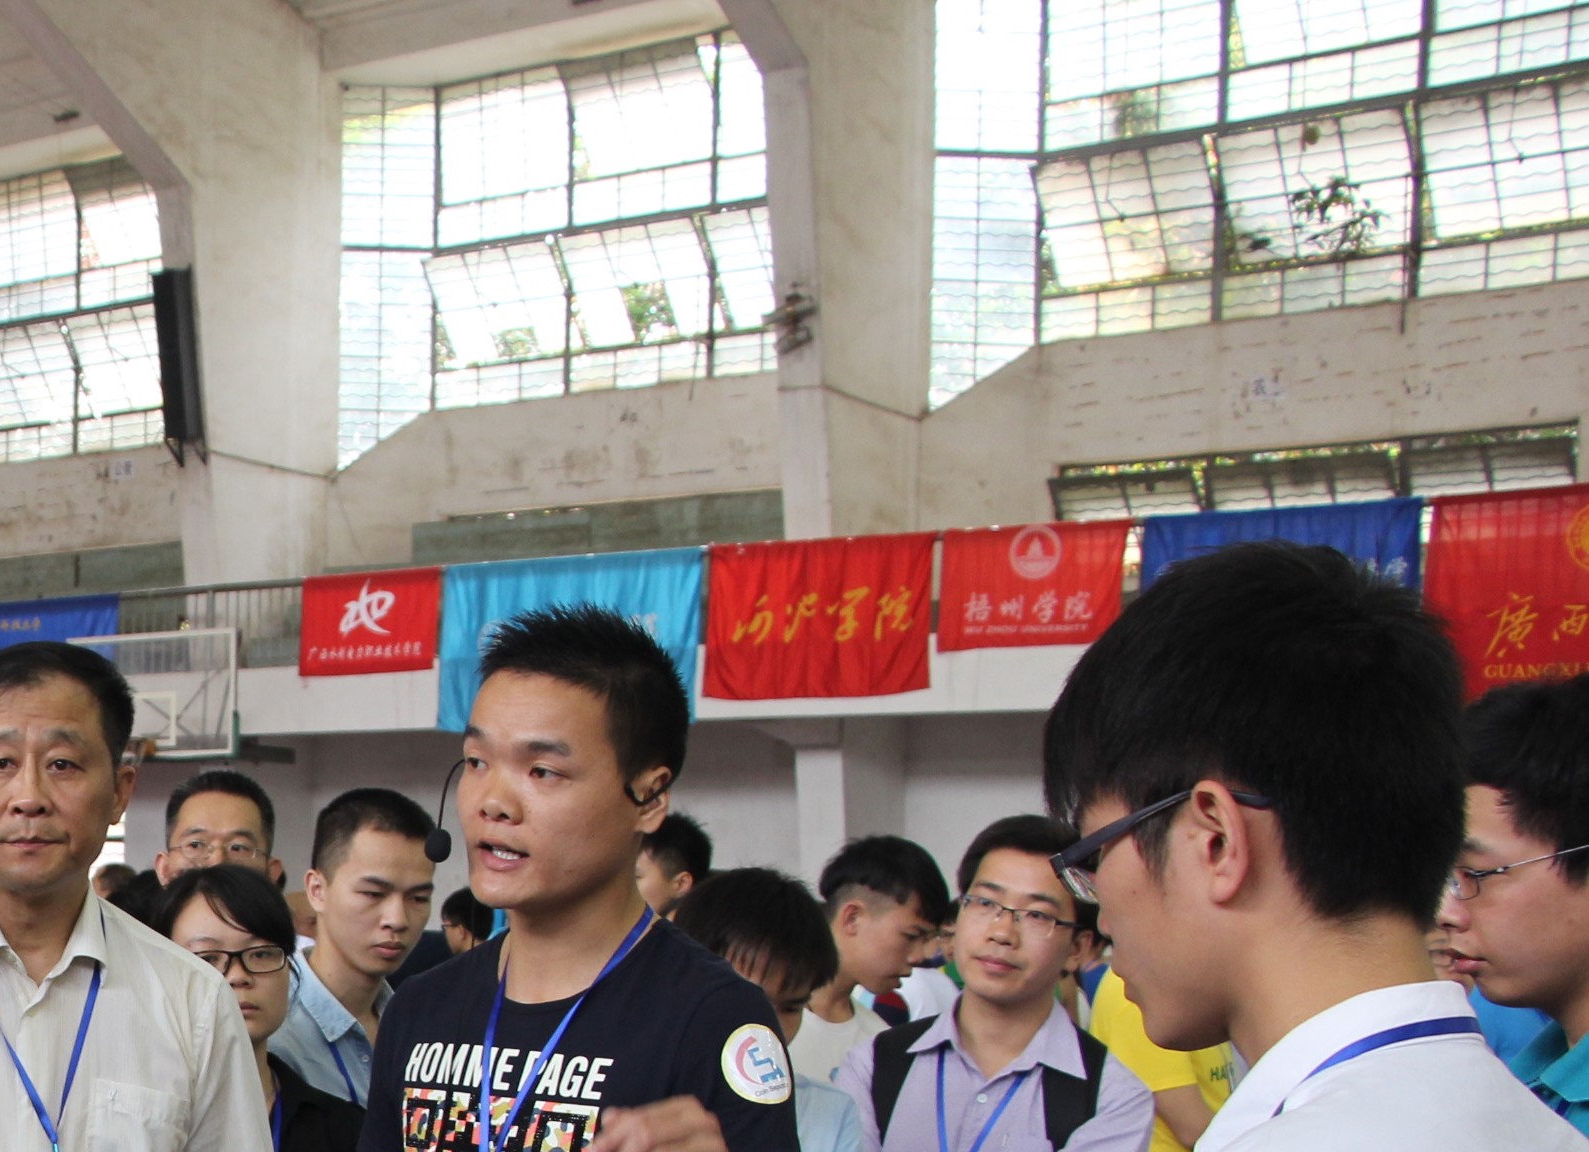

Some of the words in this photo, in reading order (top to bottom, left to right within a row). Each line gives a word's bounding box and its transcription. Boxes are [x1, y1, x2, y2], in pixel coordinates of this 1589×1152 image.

[964, 589, 1093, 623] 梧州学院
[1020, 622, 1088, 633] UNIVERSITY
[404, 1042, 520, 1091] HOMME
[518, 1050, 614, 1100] PAGE
